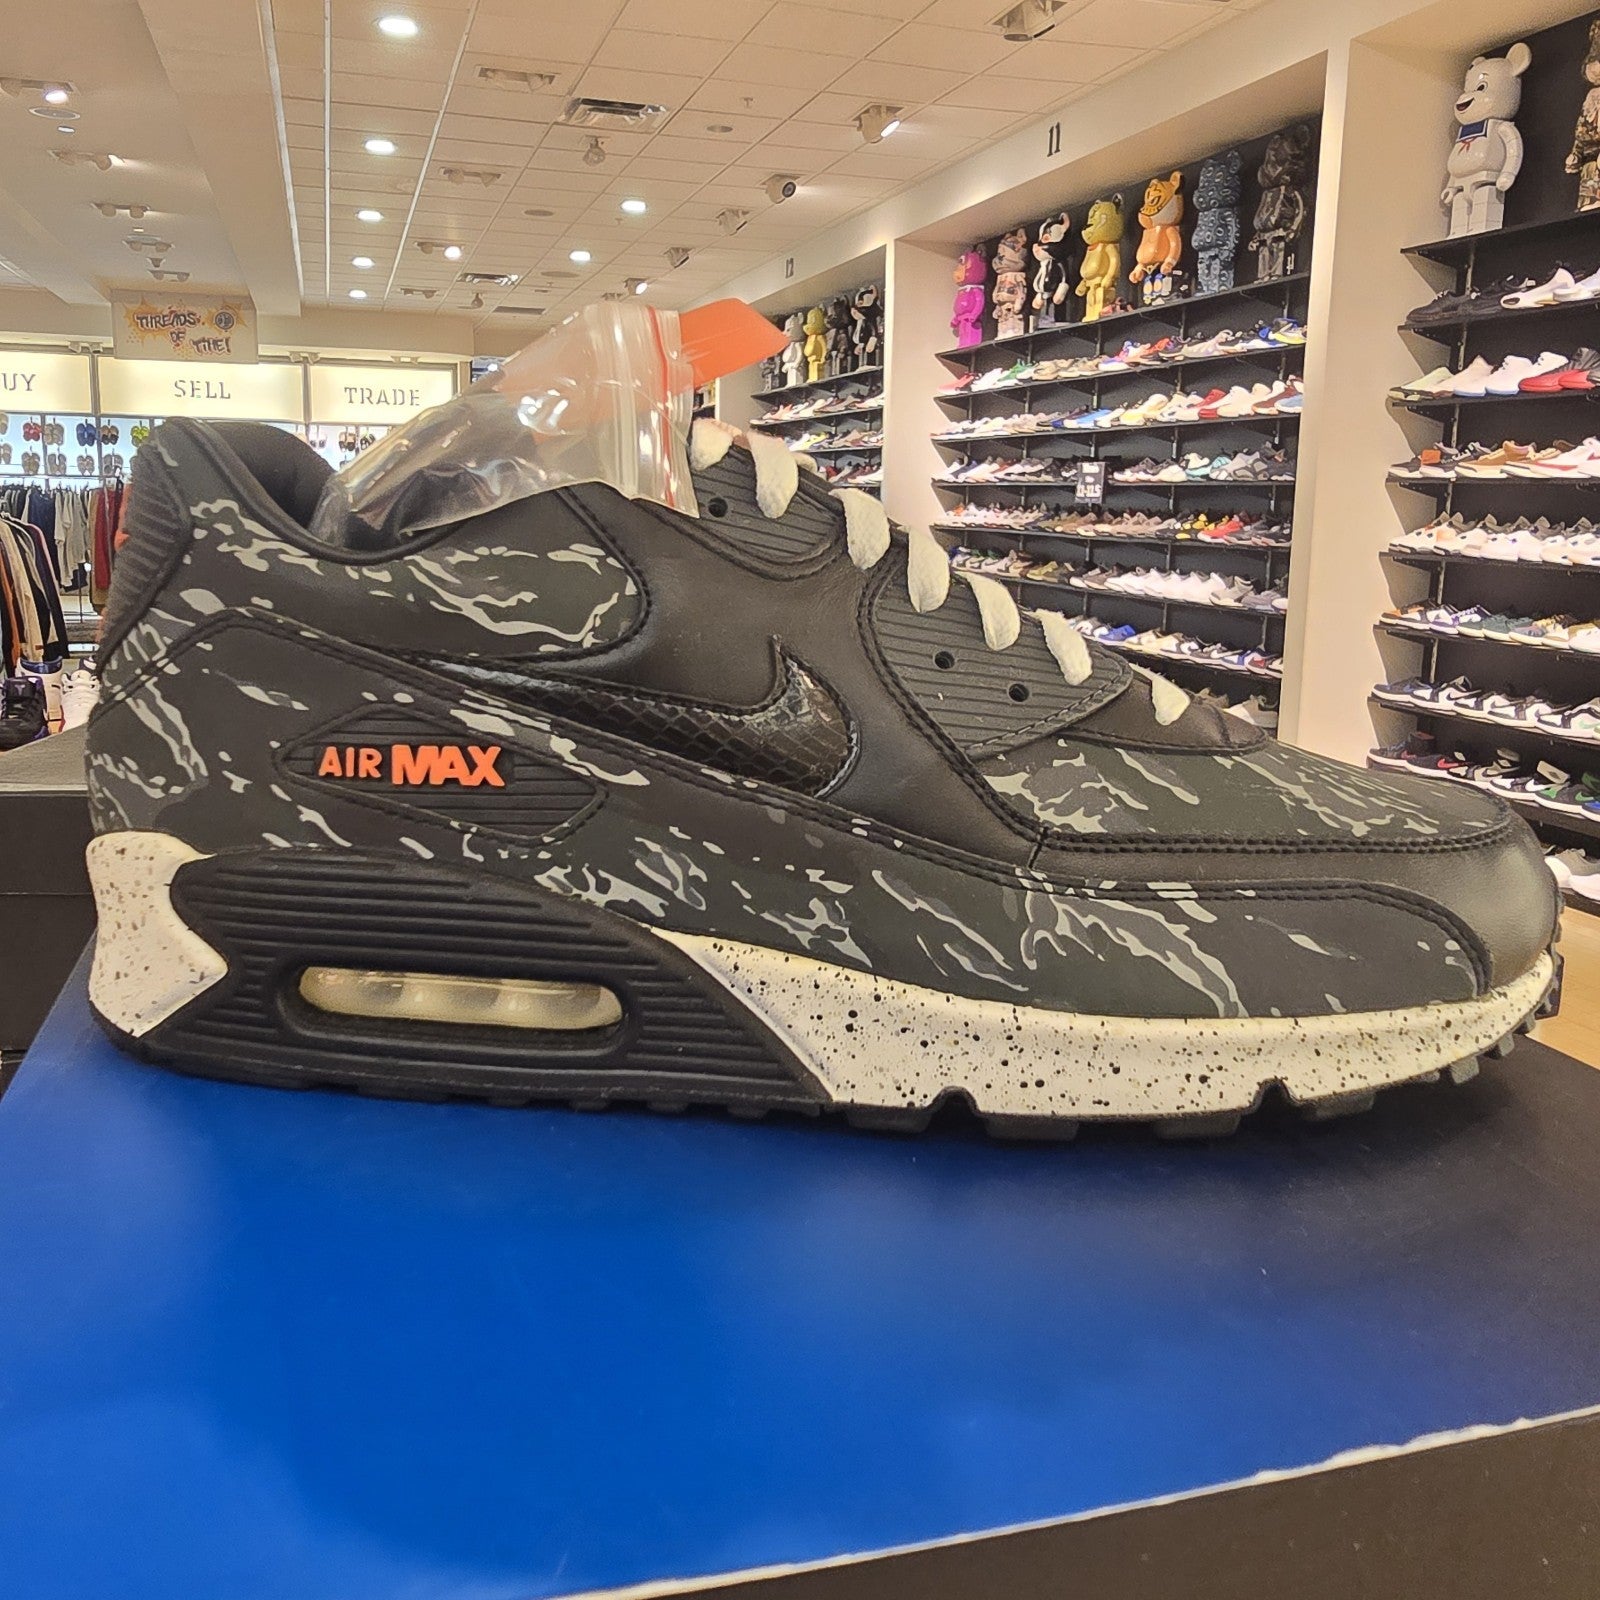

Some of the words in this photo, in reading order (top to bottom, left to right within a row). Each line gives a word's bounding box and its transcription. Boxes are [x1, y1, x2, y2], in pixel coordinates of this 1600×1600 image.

[1046, 121, 1061, 157] 11
[136, 311, 197, 329] THREADS
[173, 379, 232, 400] SELL
[343, 386, 420, 406] TRADE
[318, 746, 382, 778] AIR
[391, 744, 506, 787] MAX
